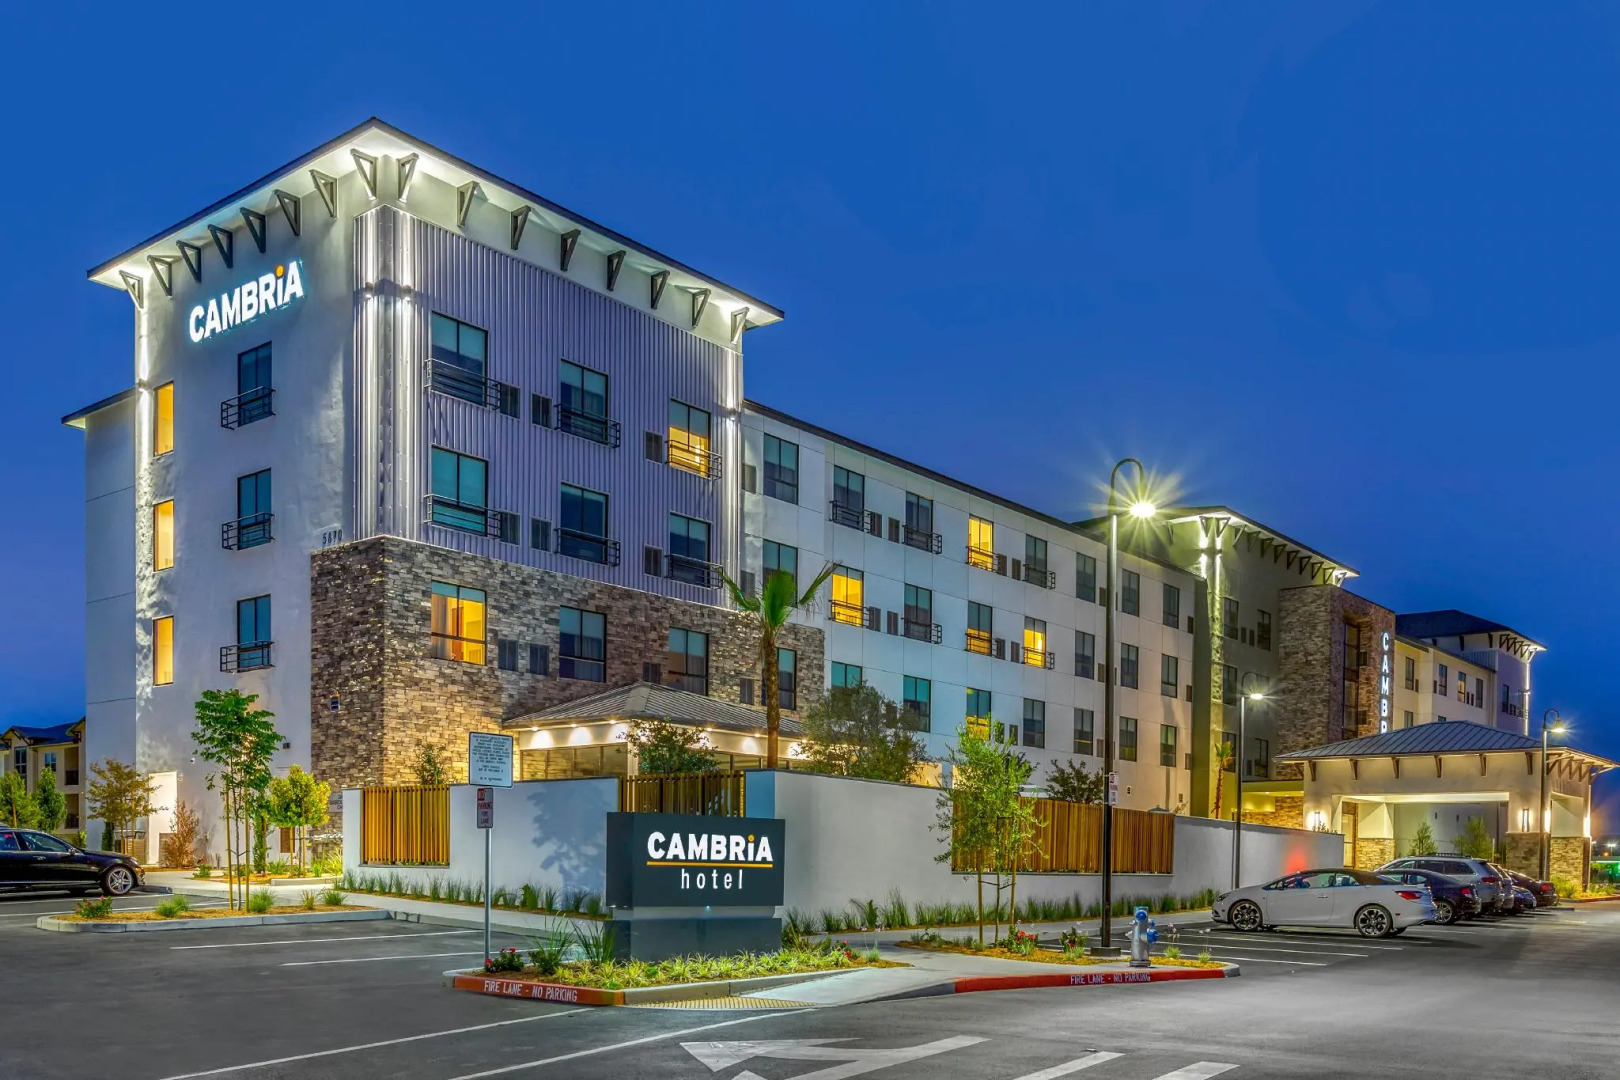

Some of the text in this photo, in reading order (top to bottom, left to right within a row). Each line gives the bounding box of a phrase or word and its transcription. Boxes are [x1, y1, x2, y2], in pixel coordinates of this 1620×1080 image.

[647, 831, 774, 862] CAMBRiA
[681, 868, 743, 890] hotel
[1070, 975, 1086, 985] FIRE
[1088, 974, 1106, 984] LANE
[1113, 973, 1123, 983] NO
[1124, 972, 1151, 982] PARKING
[484, 980, 500, 993] FIRE
[503, 983, 523, 996] LANE
[531, 985, 543, 998] NO
[545, 987, 578, 1002] PARKING
